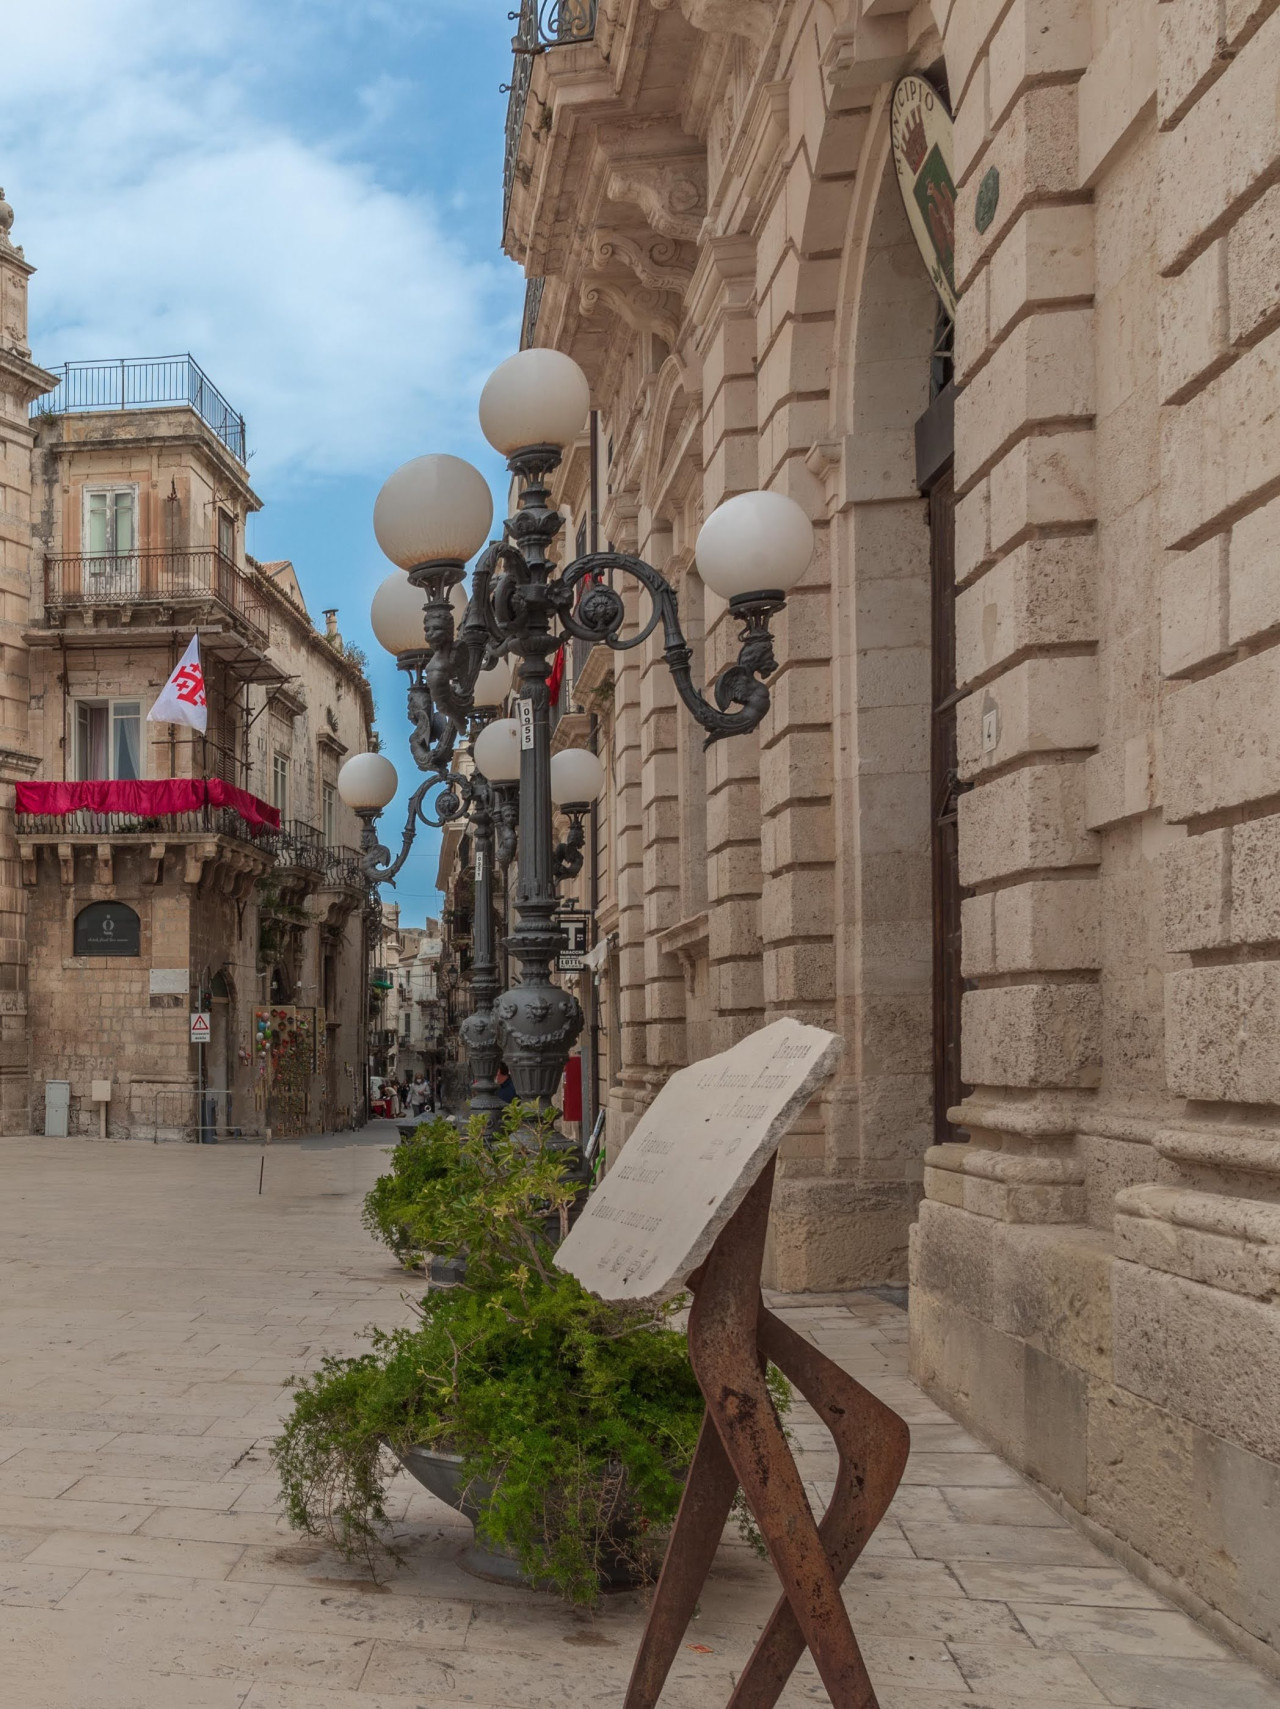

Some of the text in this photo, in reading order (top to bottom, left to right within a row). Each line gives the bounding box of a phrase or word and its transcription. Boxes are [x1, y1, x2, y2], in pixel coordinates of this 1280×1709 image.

[893, 80, 934, 175] MUNICIPIO
[523, 707, 532, 743] 0955
[986, 720, 992, 742] 4
[560, 922, 584, 950] T
